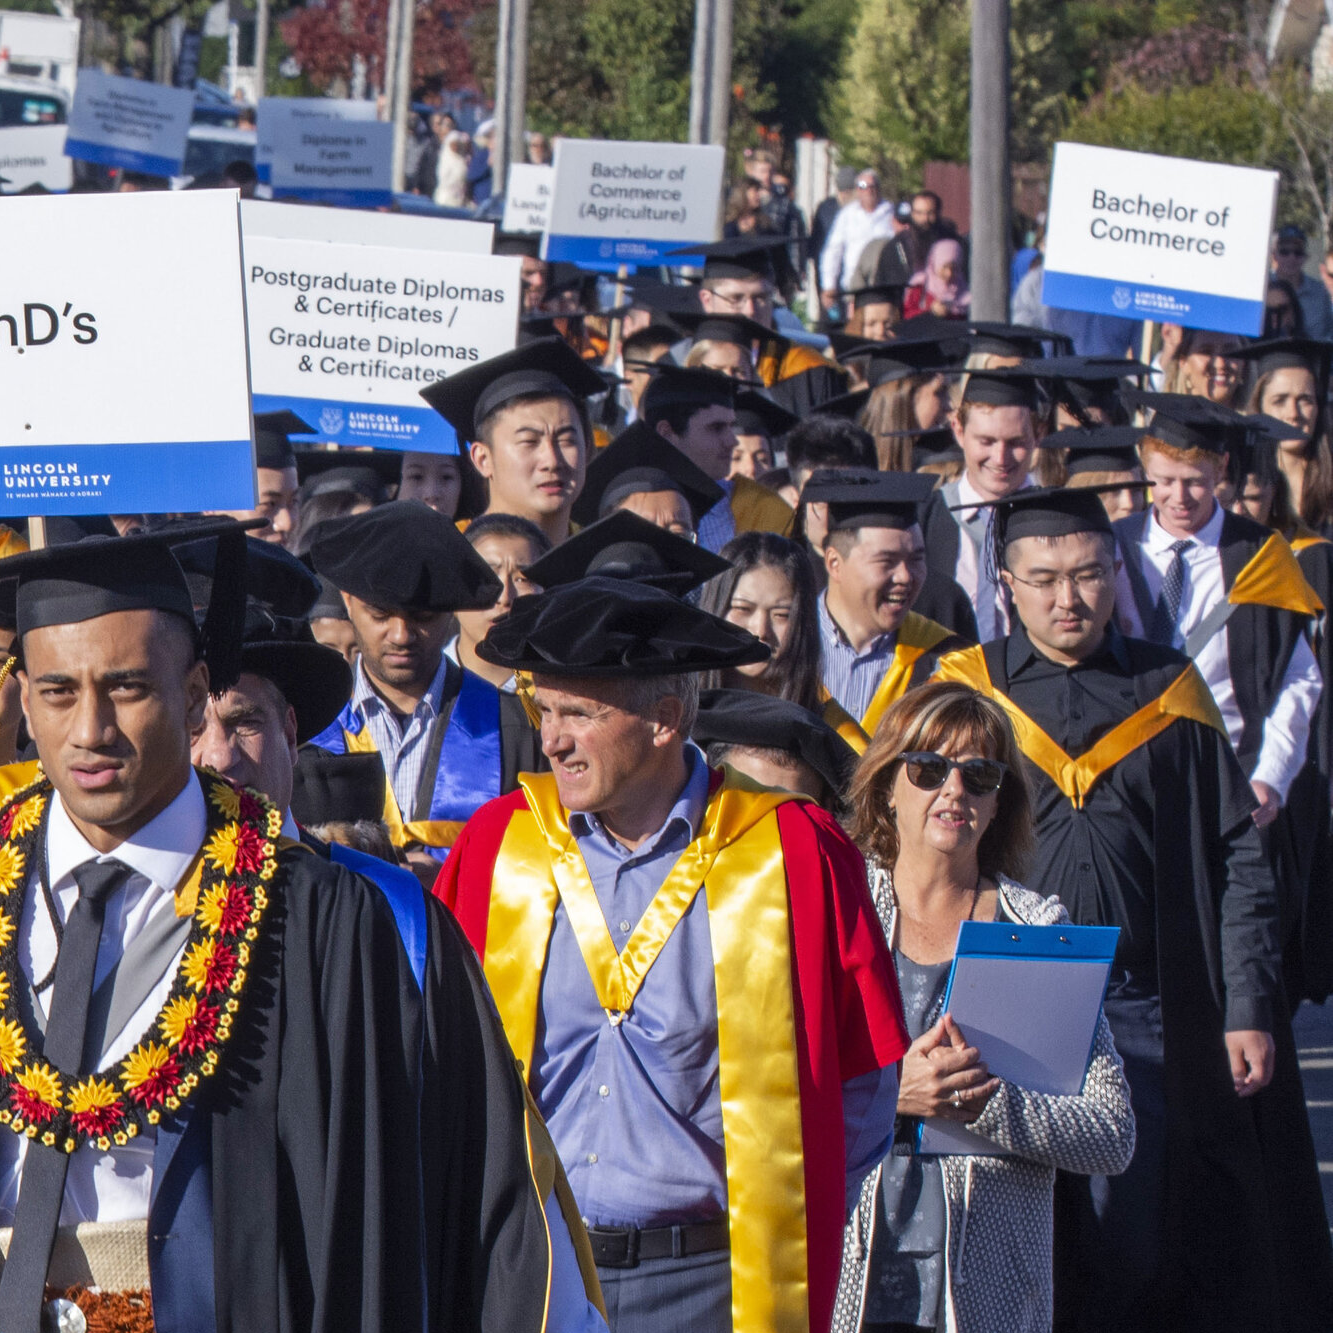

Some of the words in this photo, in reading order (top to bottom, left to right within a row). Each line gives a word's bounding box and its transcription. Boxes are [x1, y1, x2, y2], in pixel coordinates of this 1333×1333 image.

[591, 162, 664, 181] Bachelor
[669, 165, 686, 181] of
[590, 183, 682, 201] Commerce
[579, 202, 686, 223] (Agriculture)
[1092, 189, 1198, 223] Bachelor
[1205, 206, 1230, 228] of
[1090, 218, 1225, 257] Commerce
[251, 266, 397, 295] Postgraduate
[403, 278, 505, 303] Diplomas
[294, 295, 309, 313] &
[317, 297, 443, 323] Certificates
[269, 327, 371, 351] Graduate
[377, 336, 479, 361] Diplomas
[298, 354, 313, 373] &
[320, 356, 447, 382] Certificates
[349, 412, 399, 424] LINCOLN
[349, 420, 420, 434] UNIVERSITY
[4, 463, 78, 475] LINCOLN
[4, 474, 111, 488] UNIVERSITY
